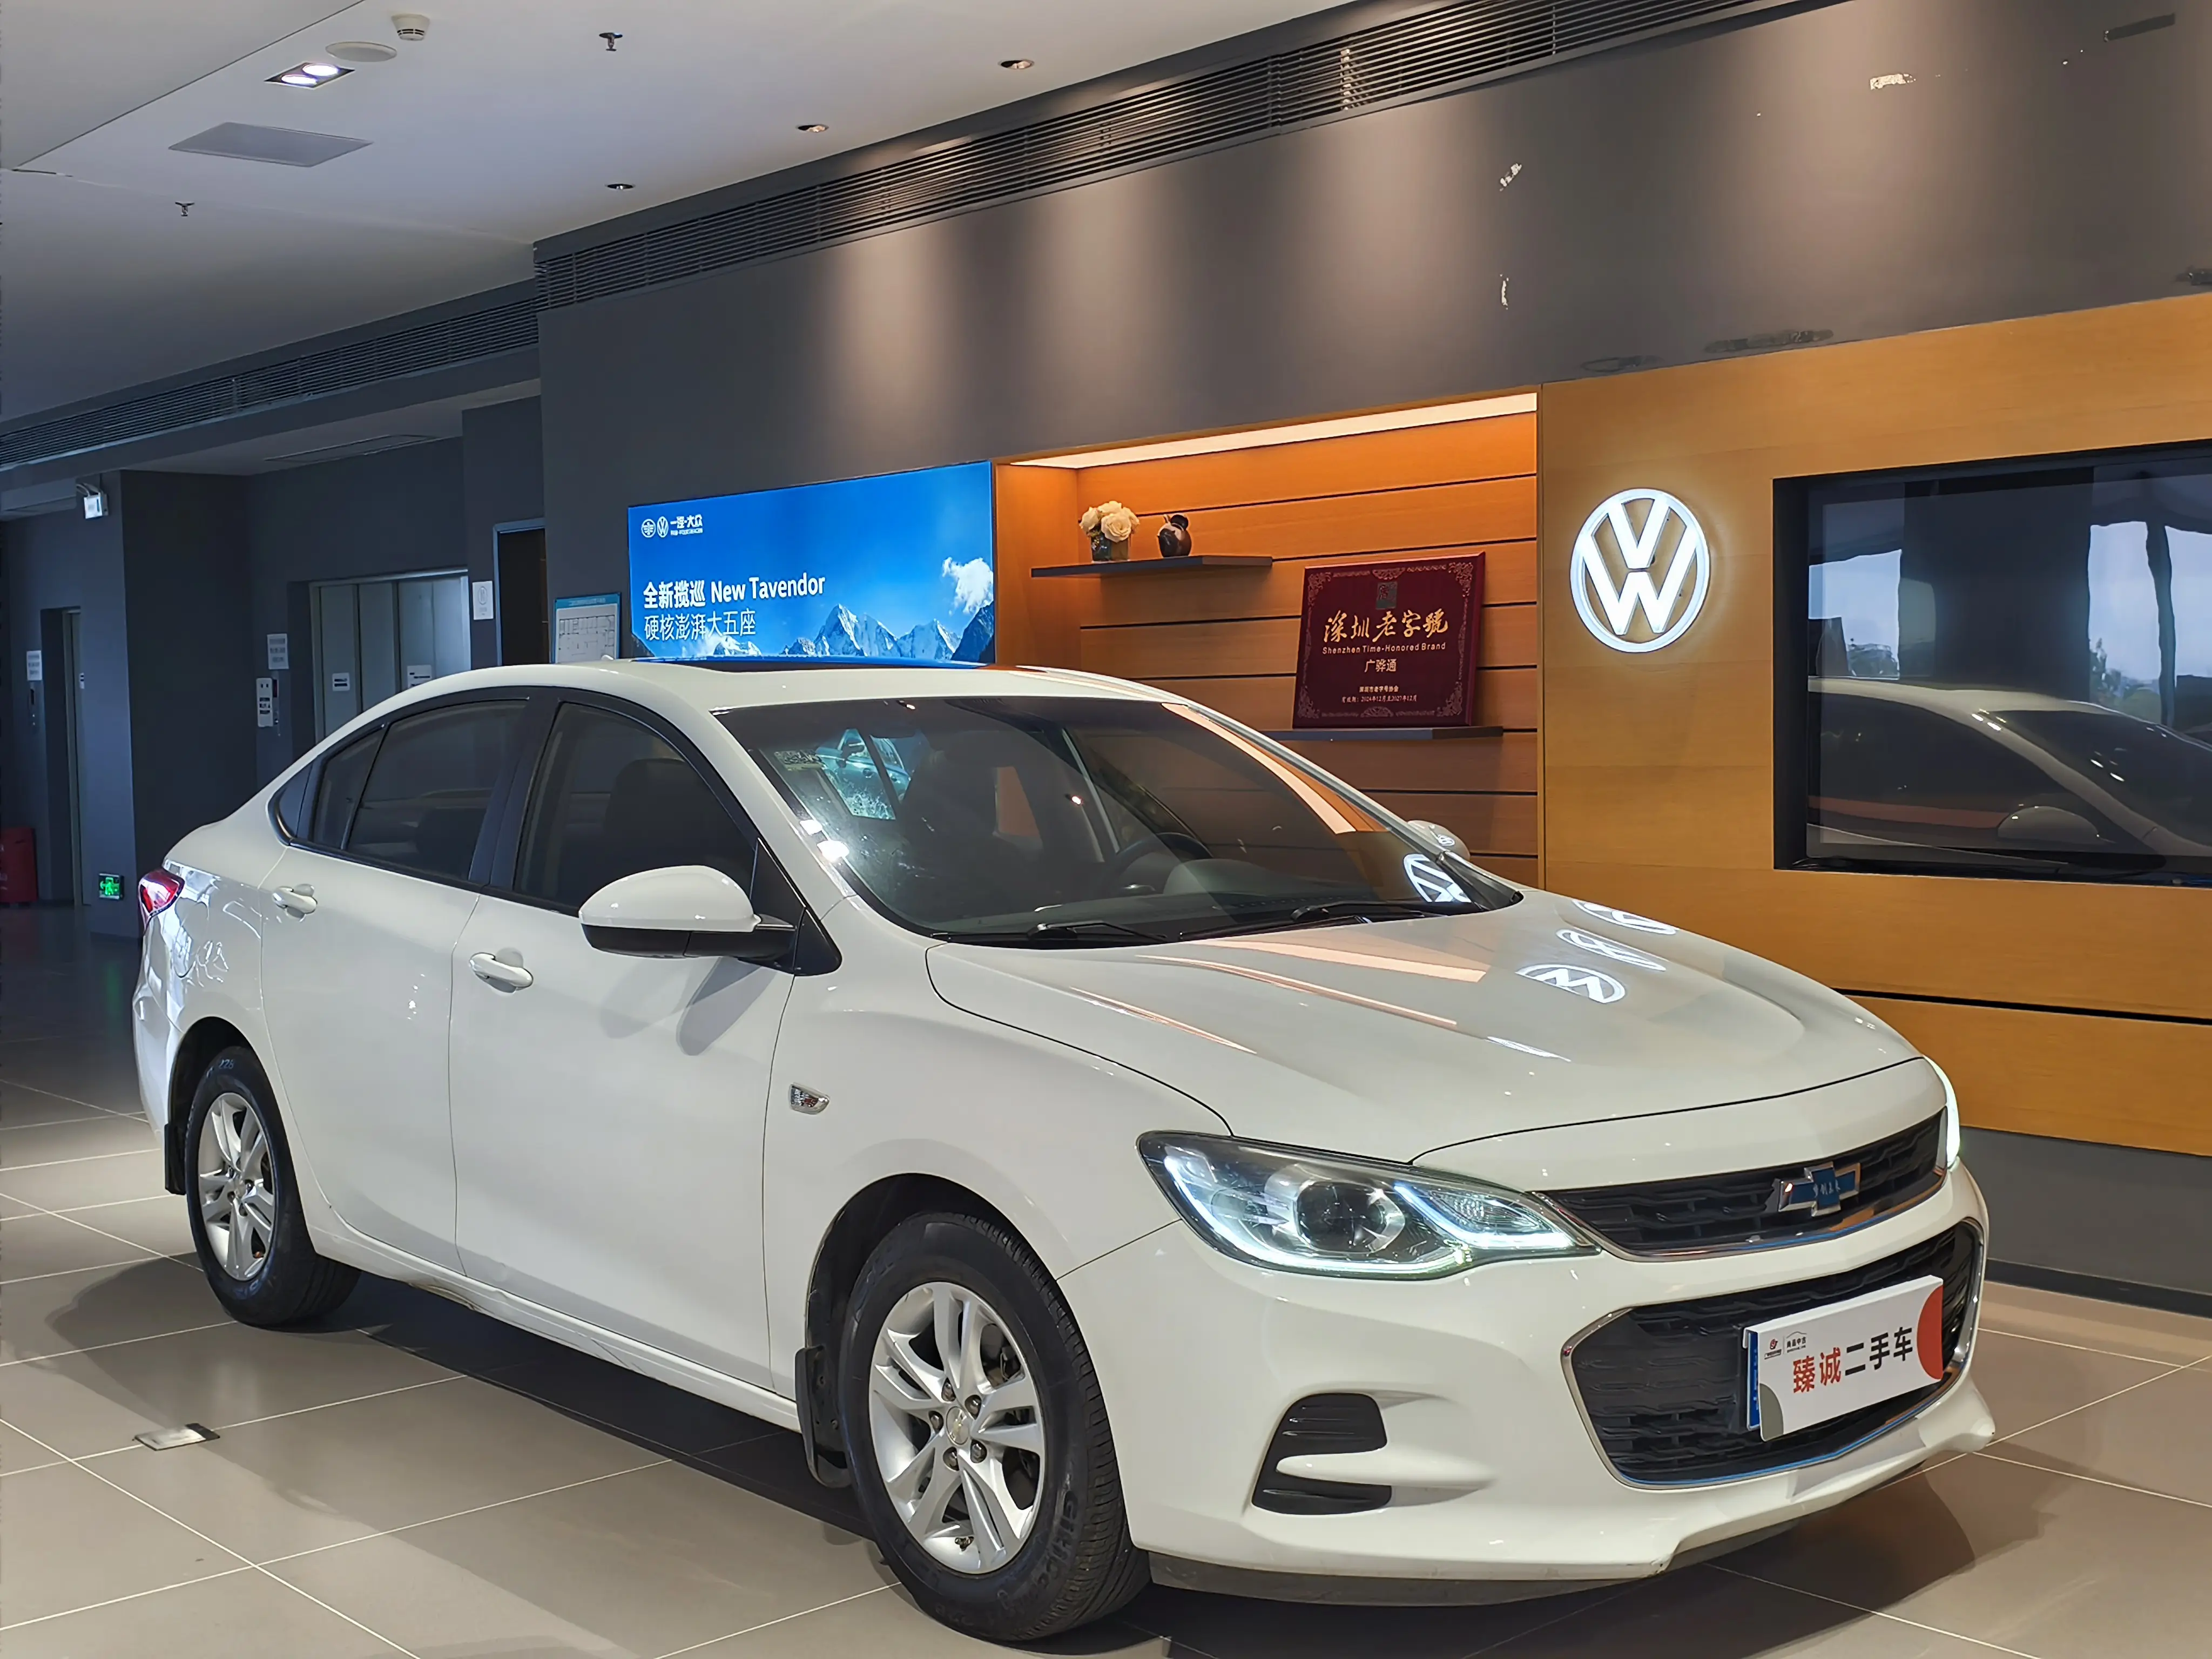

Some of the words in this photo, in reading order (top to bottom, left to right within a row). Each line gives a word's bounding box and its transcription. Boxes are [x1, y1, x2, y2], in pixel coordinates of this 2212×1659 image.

[643, 579, 706, 609] 全新揽巡
[711, 581, 746, 603] New
[748, 572, 826, 599] Tavendor
[644, 608, 756, 641] 硬核澎湃大五座
[1322, 646, 1360, 655] Shenzhen
[1363, 643, 1419, 653] Time-Honored
[1421, 642, 1446, 651] Brand
[1364, 658, 1397, 673] 广骅通
[1793, 1326, 1913, 1393] 臻诚二手车
